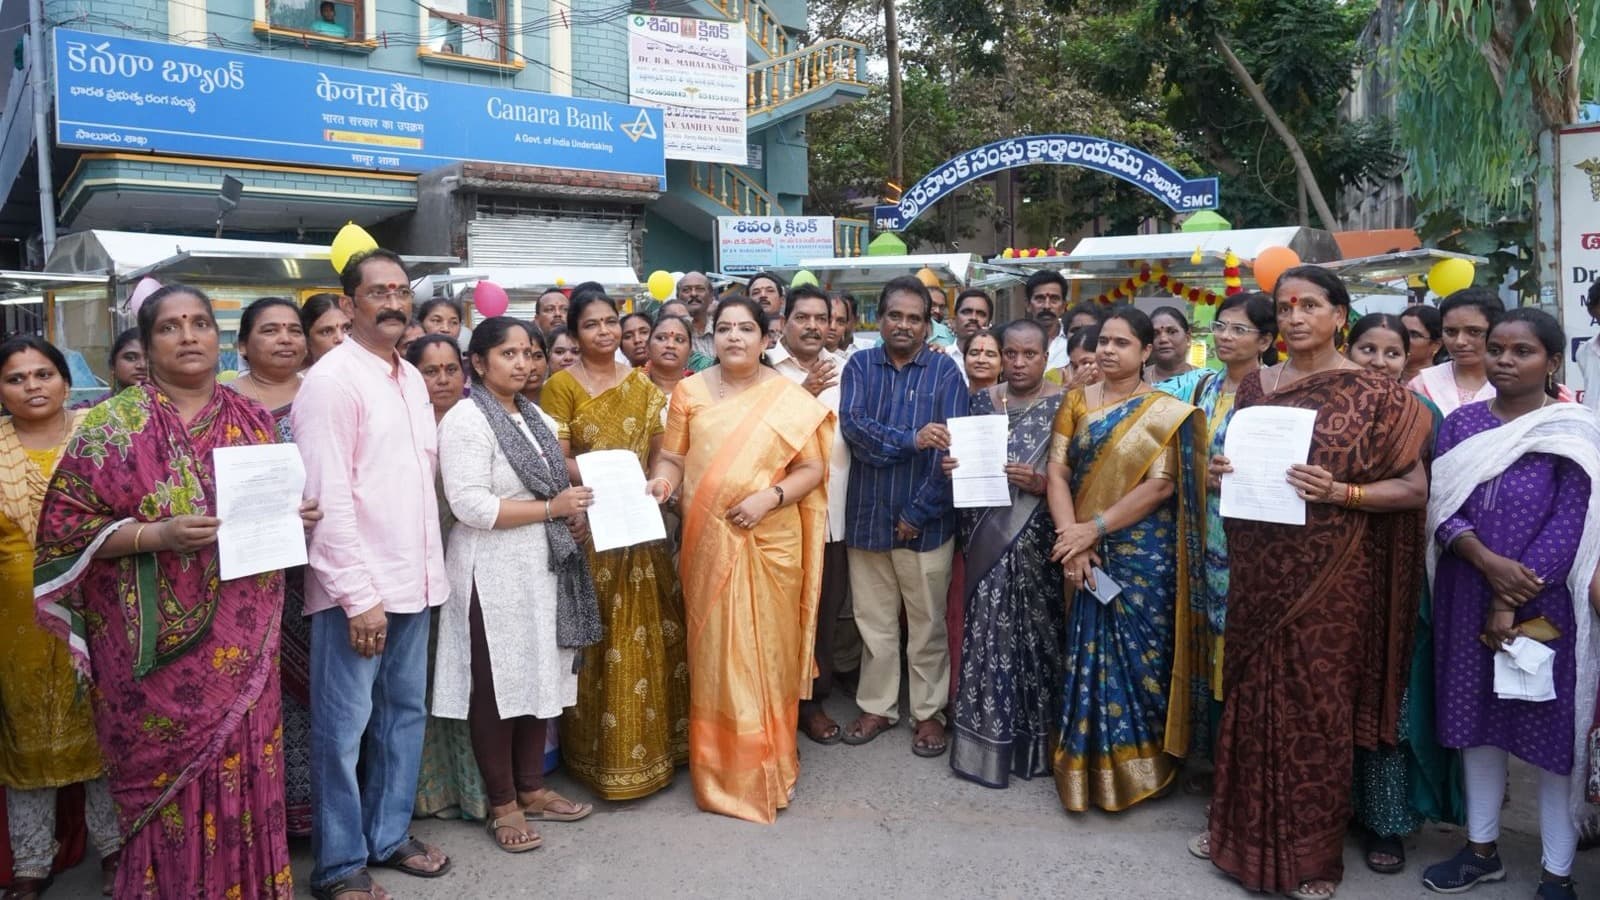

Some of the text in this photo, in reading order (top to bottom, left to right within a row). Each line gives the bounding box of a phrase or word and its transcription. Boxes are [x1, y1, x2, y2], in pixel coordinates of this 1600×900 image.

[66, 41, 245, 94] కెనరా బ్యాంక్
[70, 86, 104, 98] భారత
[145, 93, 169, 105] రంగ
[316, 72, 429, 112] केनरा बैंक
[322, 113, 424, 133] भारत सरकार का उपक्रम
[487, 96, 615, 133] Canara Bank
[514, 133, 614, 153] A Govt. of India Undertaking
[898, 157, 970, 220] పురపాలక
[1182, 194, 1213, 208] SMC
[733, 220, 771, 233] శివం
[876, 217, 900, 229] SMC
